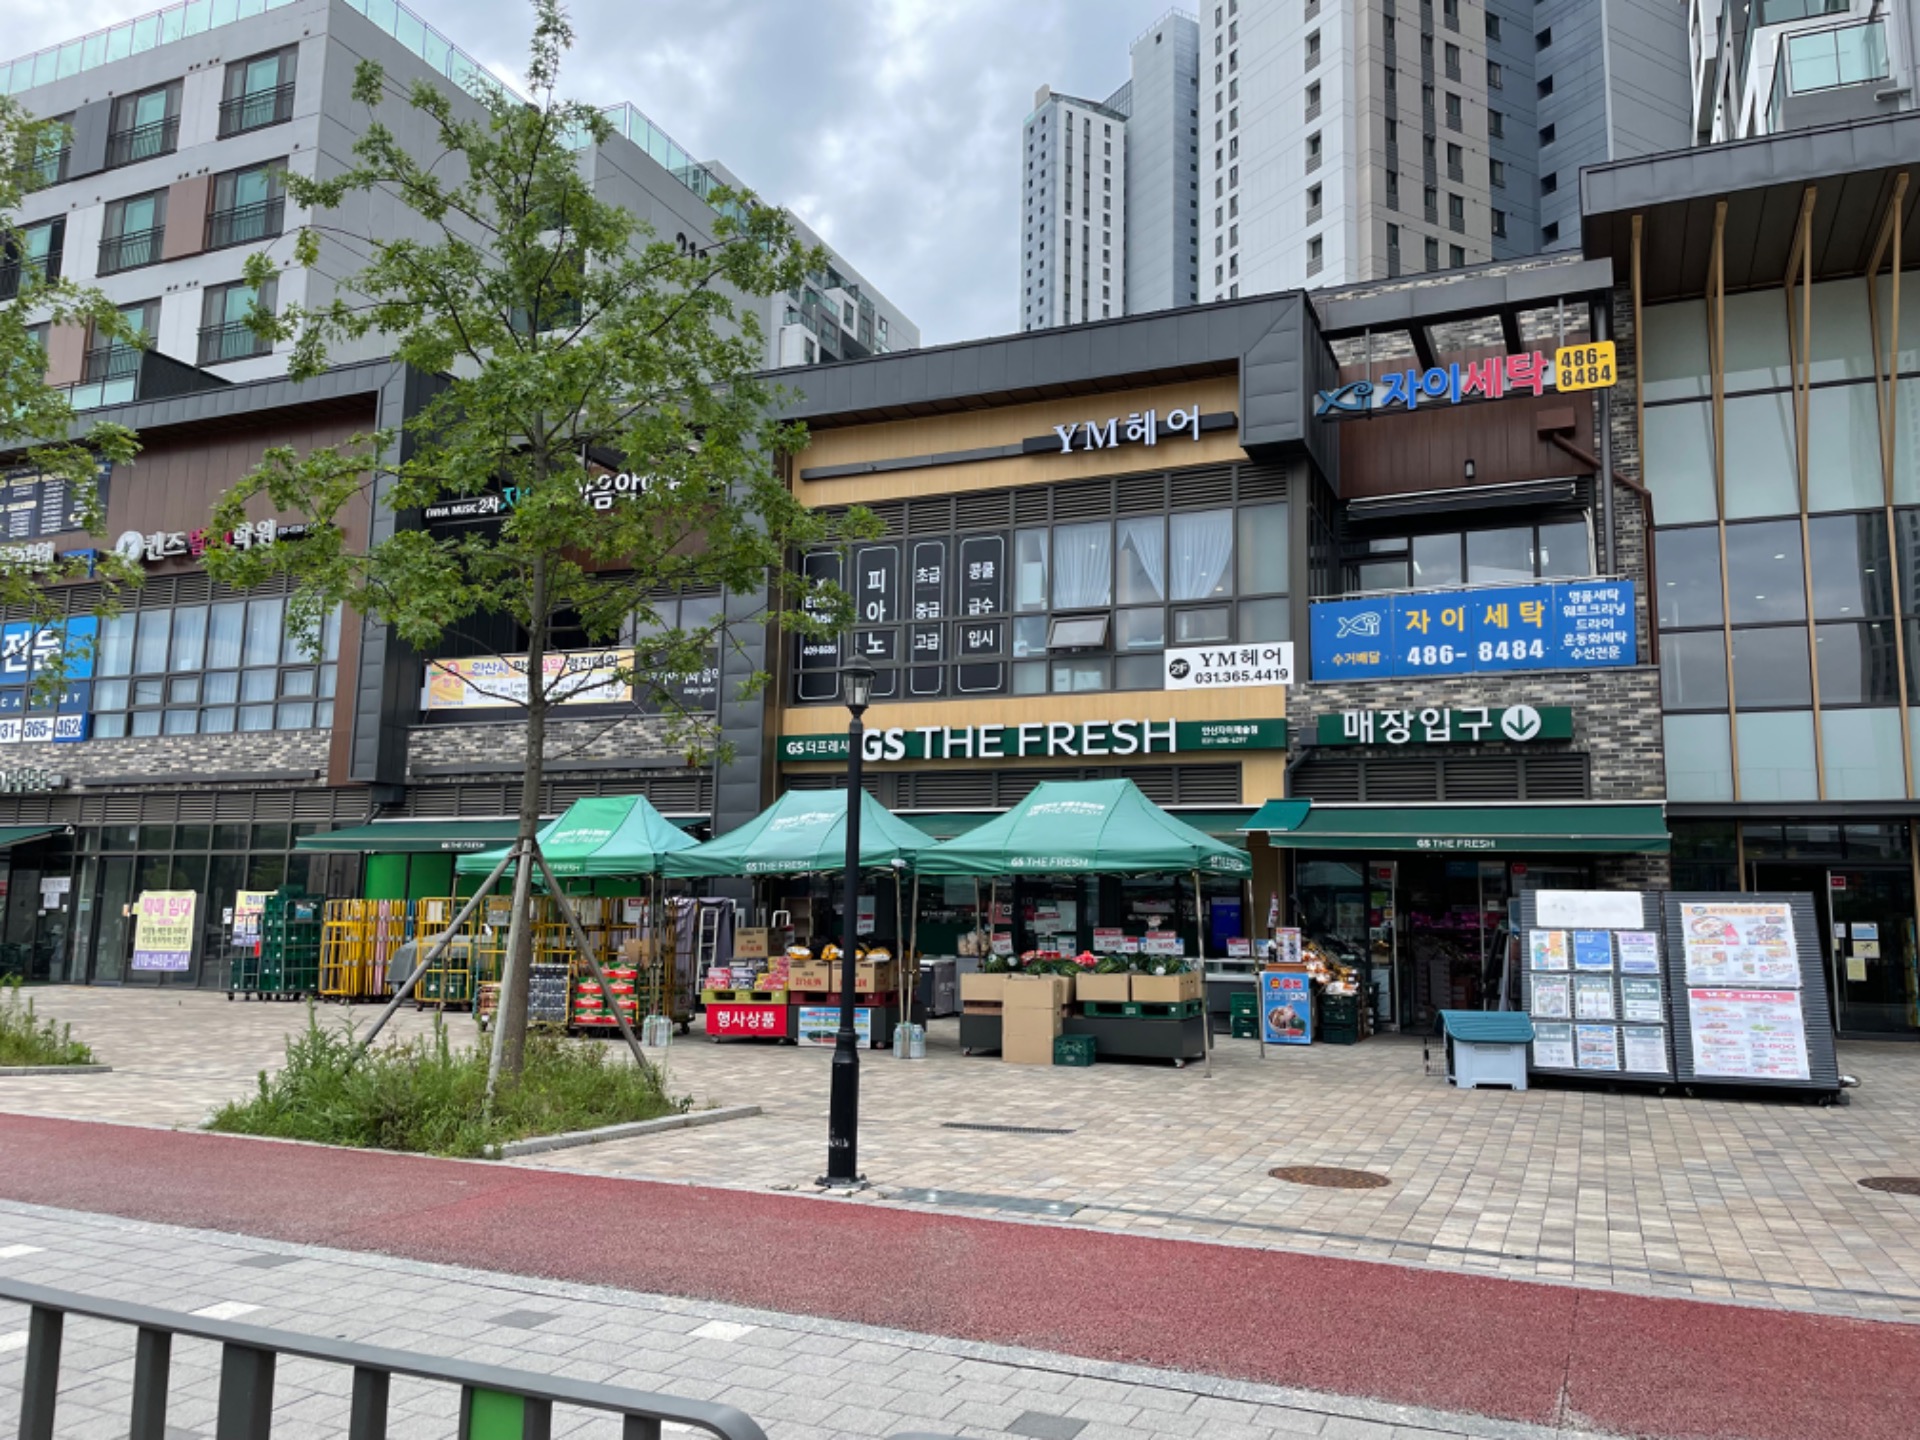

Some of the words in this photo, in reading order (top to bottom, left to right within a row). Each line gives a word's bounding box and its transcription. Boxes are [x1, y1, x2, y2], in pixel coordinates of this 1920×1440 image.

[1560, 347, 1609, 368] 486-
[1382, 351, 1548, 409] 자이세탁
[1561, 364, 1612, 387] 8484
[916, 566, 941, 584] 초급
[1569, 588, 1620, 604] 명품세탁
[915, 601, 940, 620] 중급
[968, 597, 994, 615] 급수
[1575, 617, 1615, 631] 드라이
[914, 633, 939, 650] 고급
[968, 629, 994, 648] 입시
[1563, 630, 1628, 646] 운동화세탁
[1571, 645, 1622, 660] 수선전문
[1195, 668, 1288, 684] 031.365.4419
[1343, 706, 1493, 744] 매장입구
[862, 727, 906, 761] GS
[915, 723, 1004, 759] THE
[1018, 717, 1176, 757] FRESH
[1417, 839, 1431, 848] GS
[1432, 839, 1454, 848] THE
[1455, 838, 1495, 848] FRESH
[758, 862, 776, 871] THE
[778, 861, 811, 870] FRESH
[1011, 858, 1024, 866] GS
[1026, 858, 1049, 867] THE
[1050, 857, 1089, 867] FRESH
[717, 1011, 776, 1029] 행사상품
